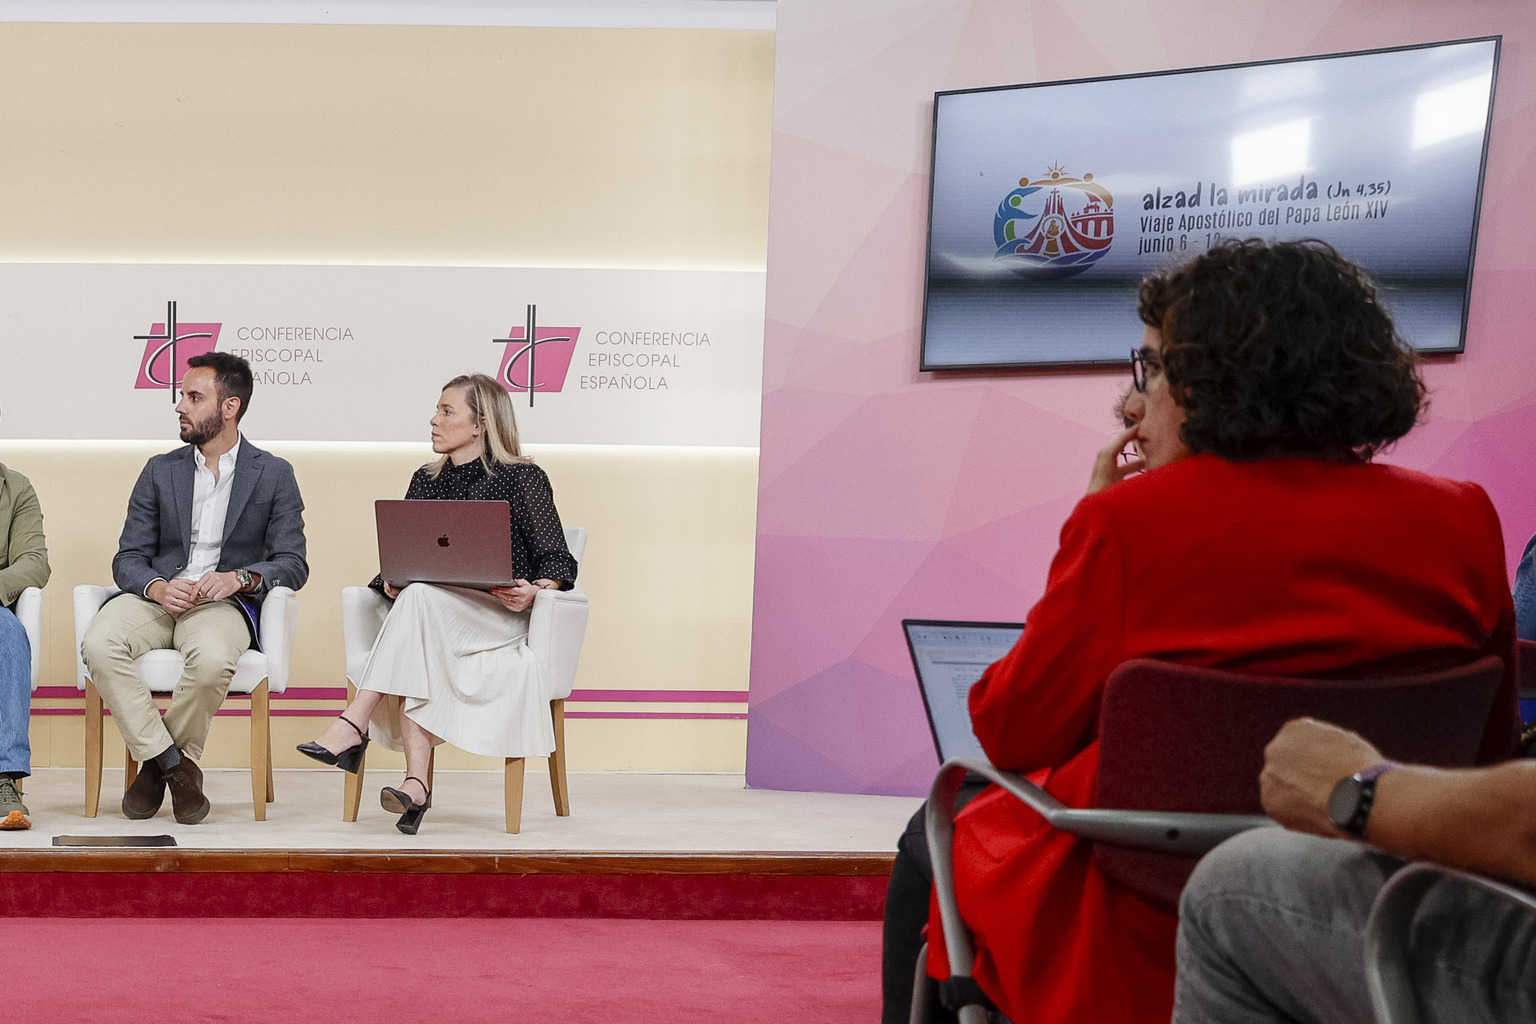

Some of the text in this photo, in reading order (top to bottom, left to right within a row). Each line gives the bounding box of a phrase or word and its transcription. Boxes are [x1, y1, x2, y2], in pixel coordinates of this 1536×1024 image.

[1142, 174, 1391, 211] alzad la mirada (Jn 4,35)
[1140, 200, 1389, 234] Viaje Apostólico del Papa León XIV
[1137, 235, 1174, 256] junio
[1179, 234, 1188, 251] 6
[236, 326, 355, 341] CONFERENCIA
[595, 331, 711, 346] CONFERENCIA
[588, 352, 681, 368] EPISCOPAL
[252, 368, 313, 385] AÑOLA
[580, 374, 669, 390] ESPAÑOLA
